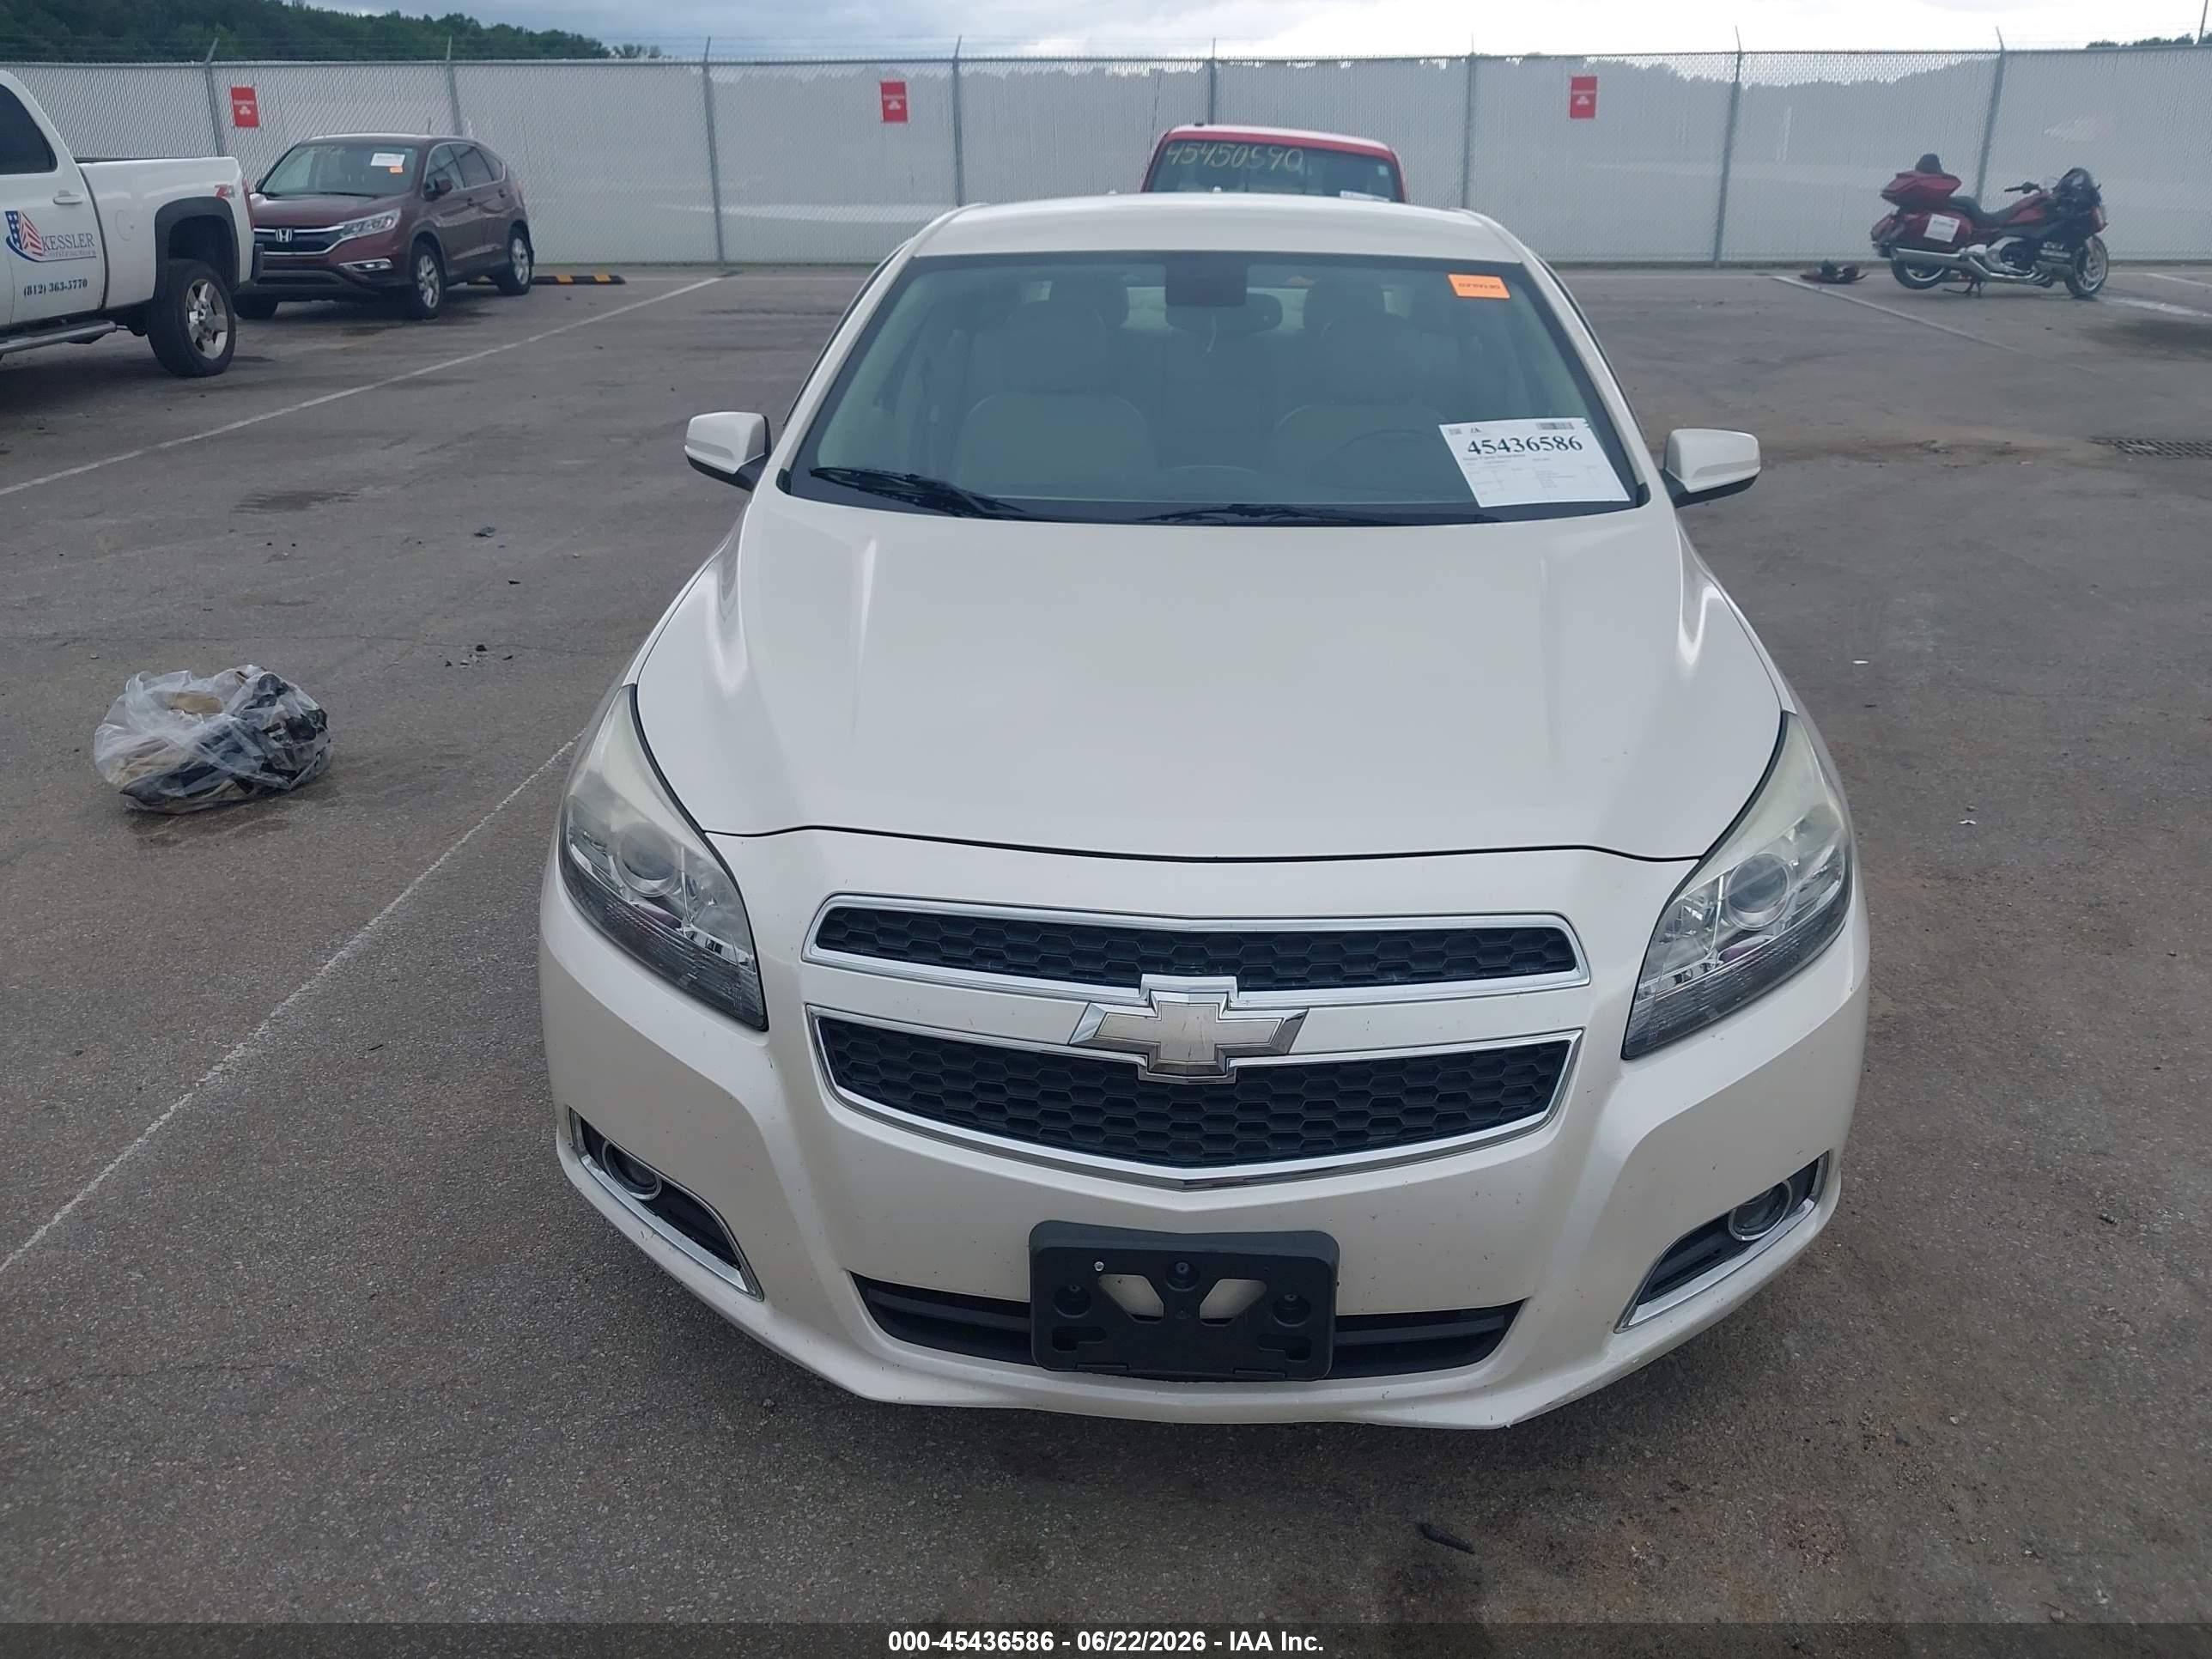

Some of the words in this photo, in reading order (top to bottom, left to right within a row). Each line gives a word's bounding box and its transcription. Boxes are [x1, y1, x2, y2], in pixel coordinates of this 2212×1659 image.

[41, 233, 94, 252] KESSLER
[23, 283, 46, 298] (812)
[1468, 435, 1583, 455] 45436586
